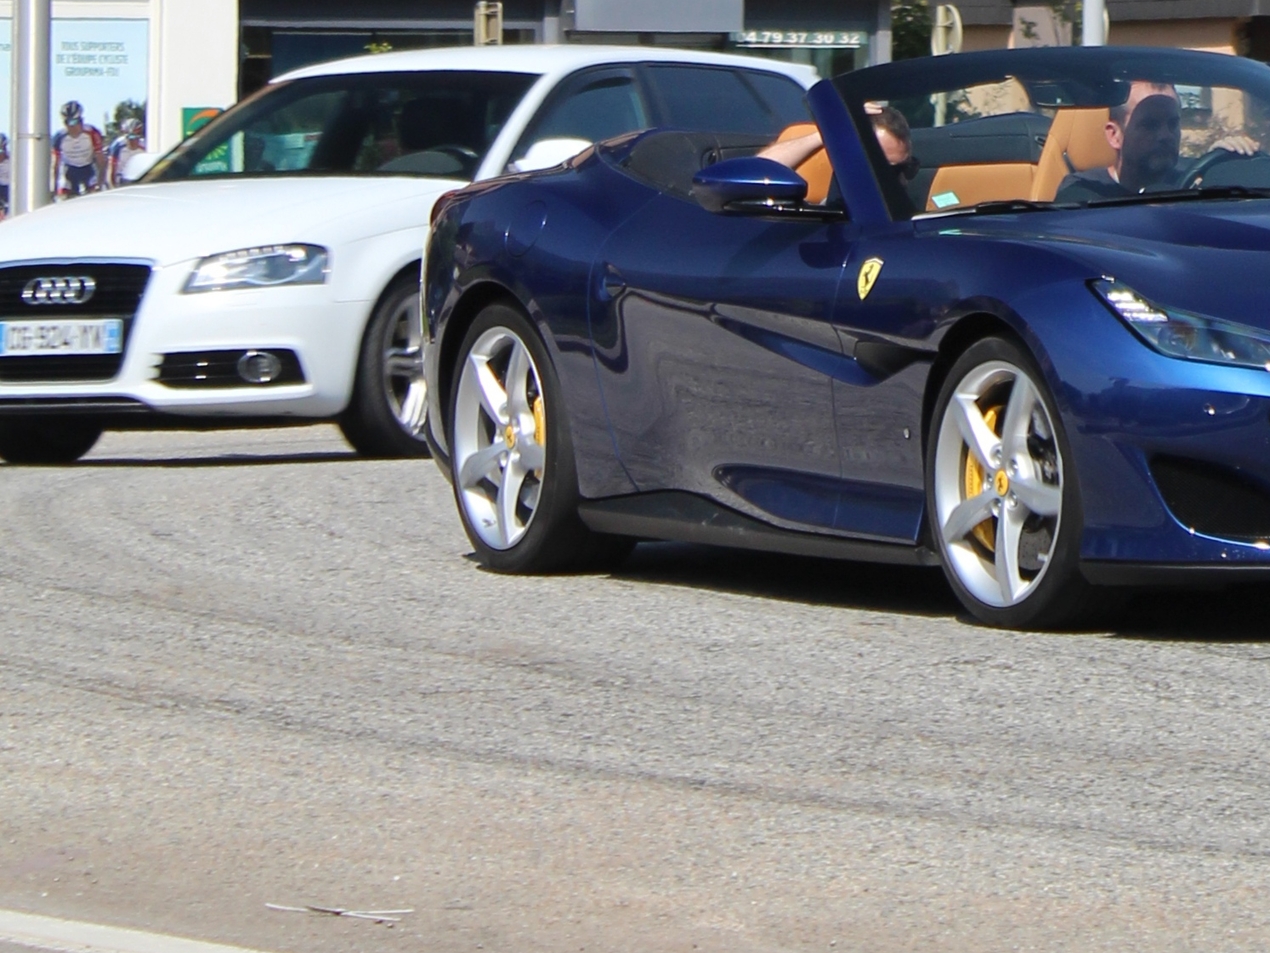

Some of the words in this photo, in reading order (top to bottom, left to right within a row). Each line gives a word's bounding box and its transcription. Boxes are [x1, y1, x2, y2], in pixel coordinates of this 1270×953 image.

[761, 32, 783, 43] 79
[786, 32, 808, 44] 37
[839, 33, 860, 45] 32
